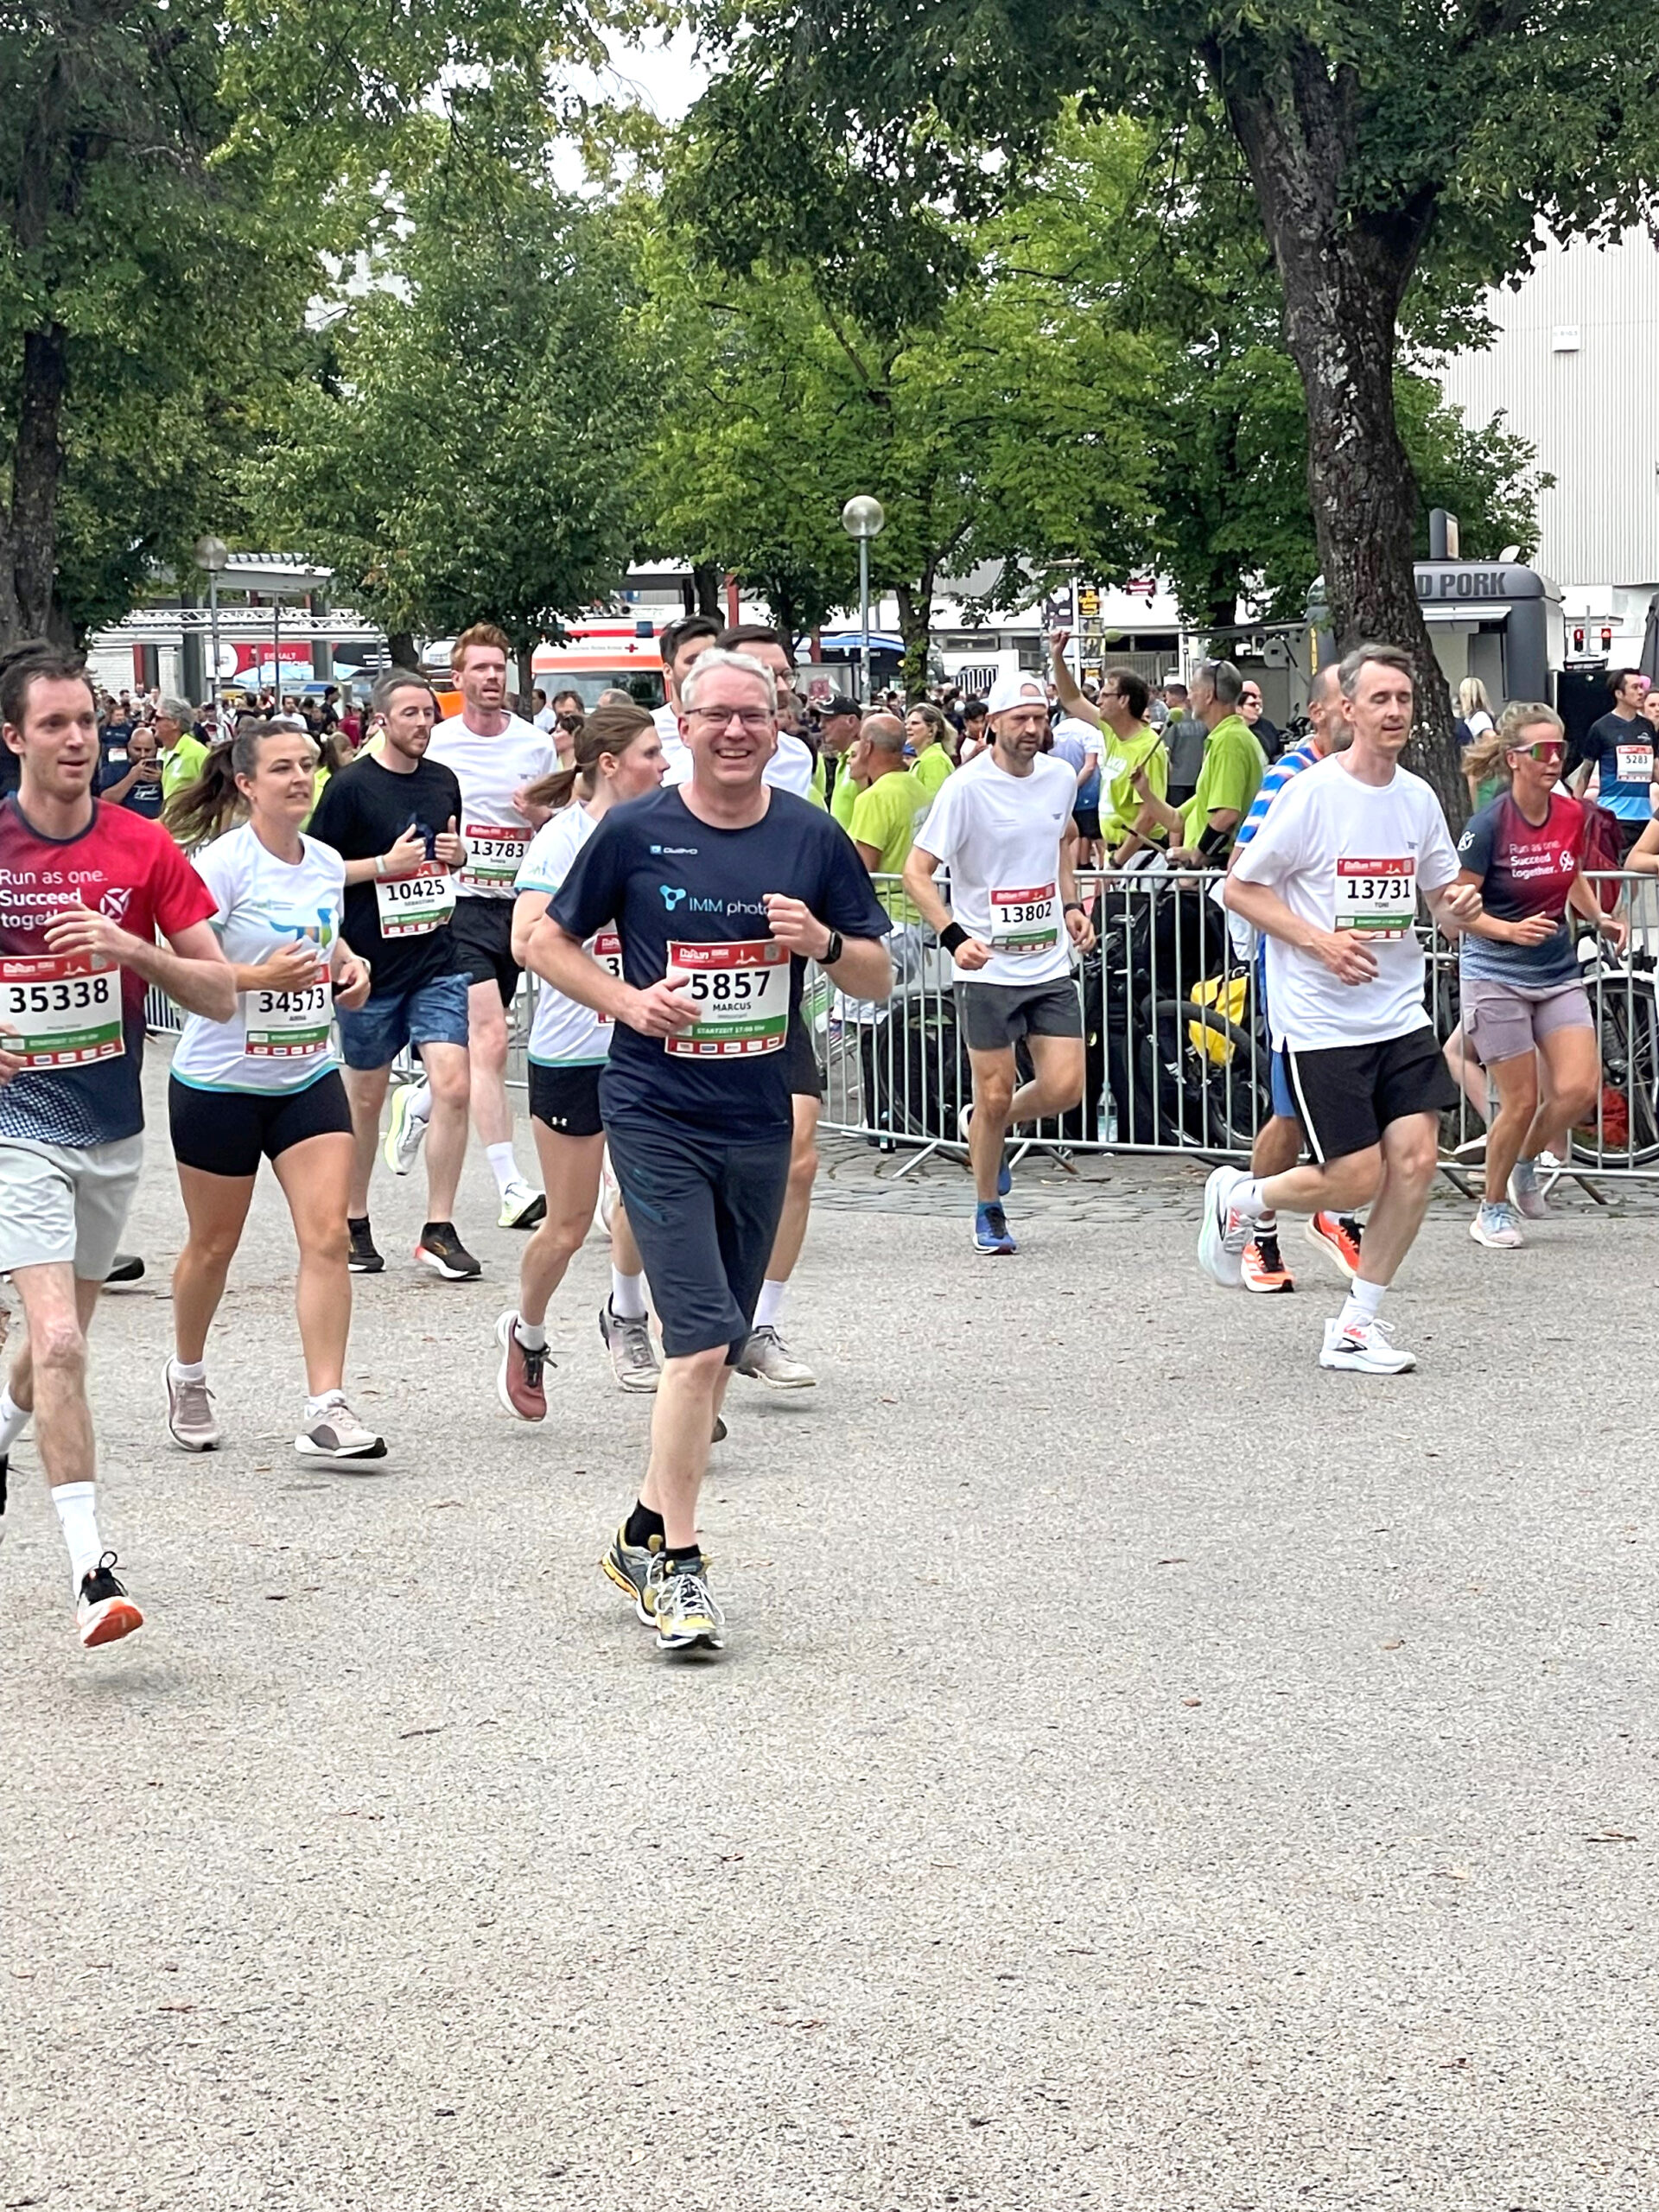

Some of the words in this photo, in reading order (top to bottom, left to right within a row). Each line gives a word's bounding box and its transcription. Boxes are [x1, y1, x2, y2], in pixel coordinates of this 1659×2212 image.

[1440, 572, 1506, 595] PORK
[1626, 755, 1648, 764] 5283
[471, 841, 524, 858] 13783
[1510, 843, 1529, 854] Run
[1532, 843, 1541, 852] as
[1510, 852, 1551, 866] Succeed
[0, 869, 36, 885] Run
[42, 871, 63, 884] as
[68, 870, 108, 884] one.
[1512, 865, 1558, 880] together.
[0, 887, 82, 906] Succeed
[386, 880, 445, 901] 10425
[1348, 879, 1410, 899] 13731
[690, 897, 722, 912] IMM
[1001, 901, 1052, 923] 13802
[680, 948, 709, 959] DaRun
[691, 970, 771, 1000] 5857
[10, 978, 109, 1014] 35338
[259, 988, 325, 1013] 34573
[713, 1002, 752, 1011] MARCUS
